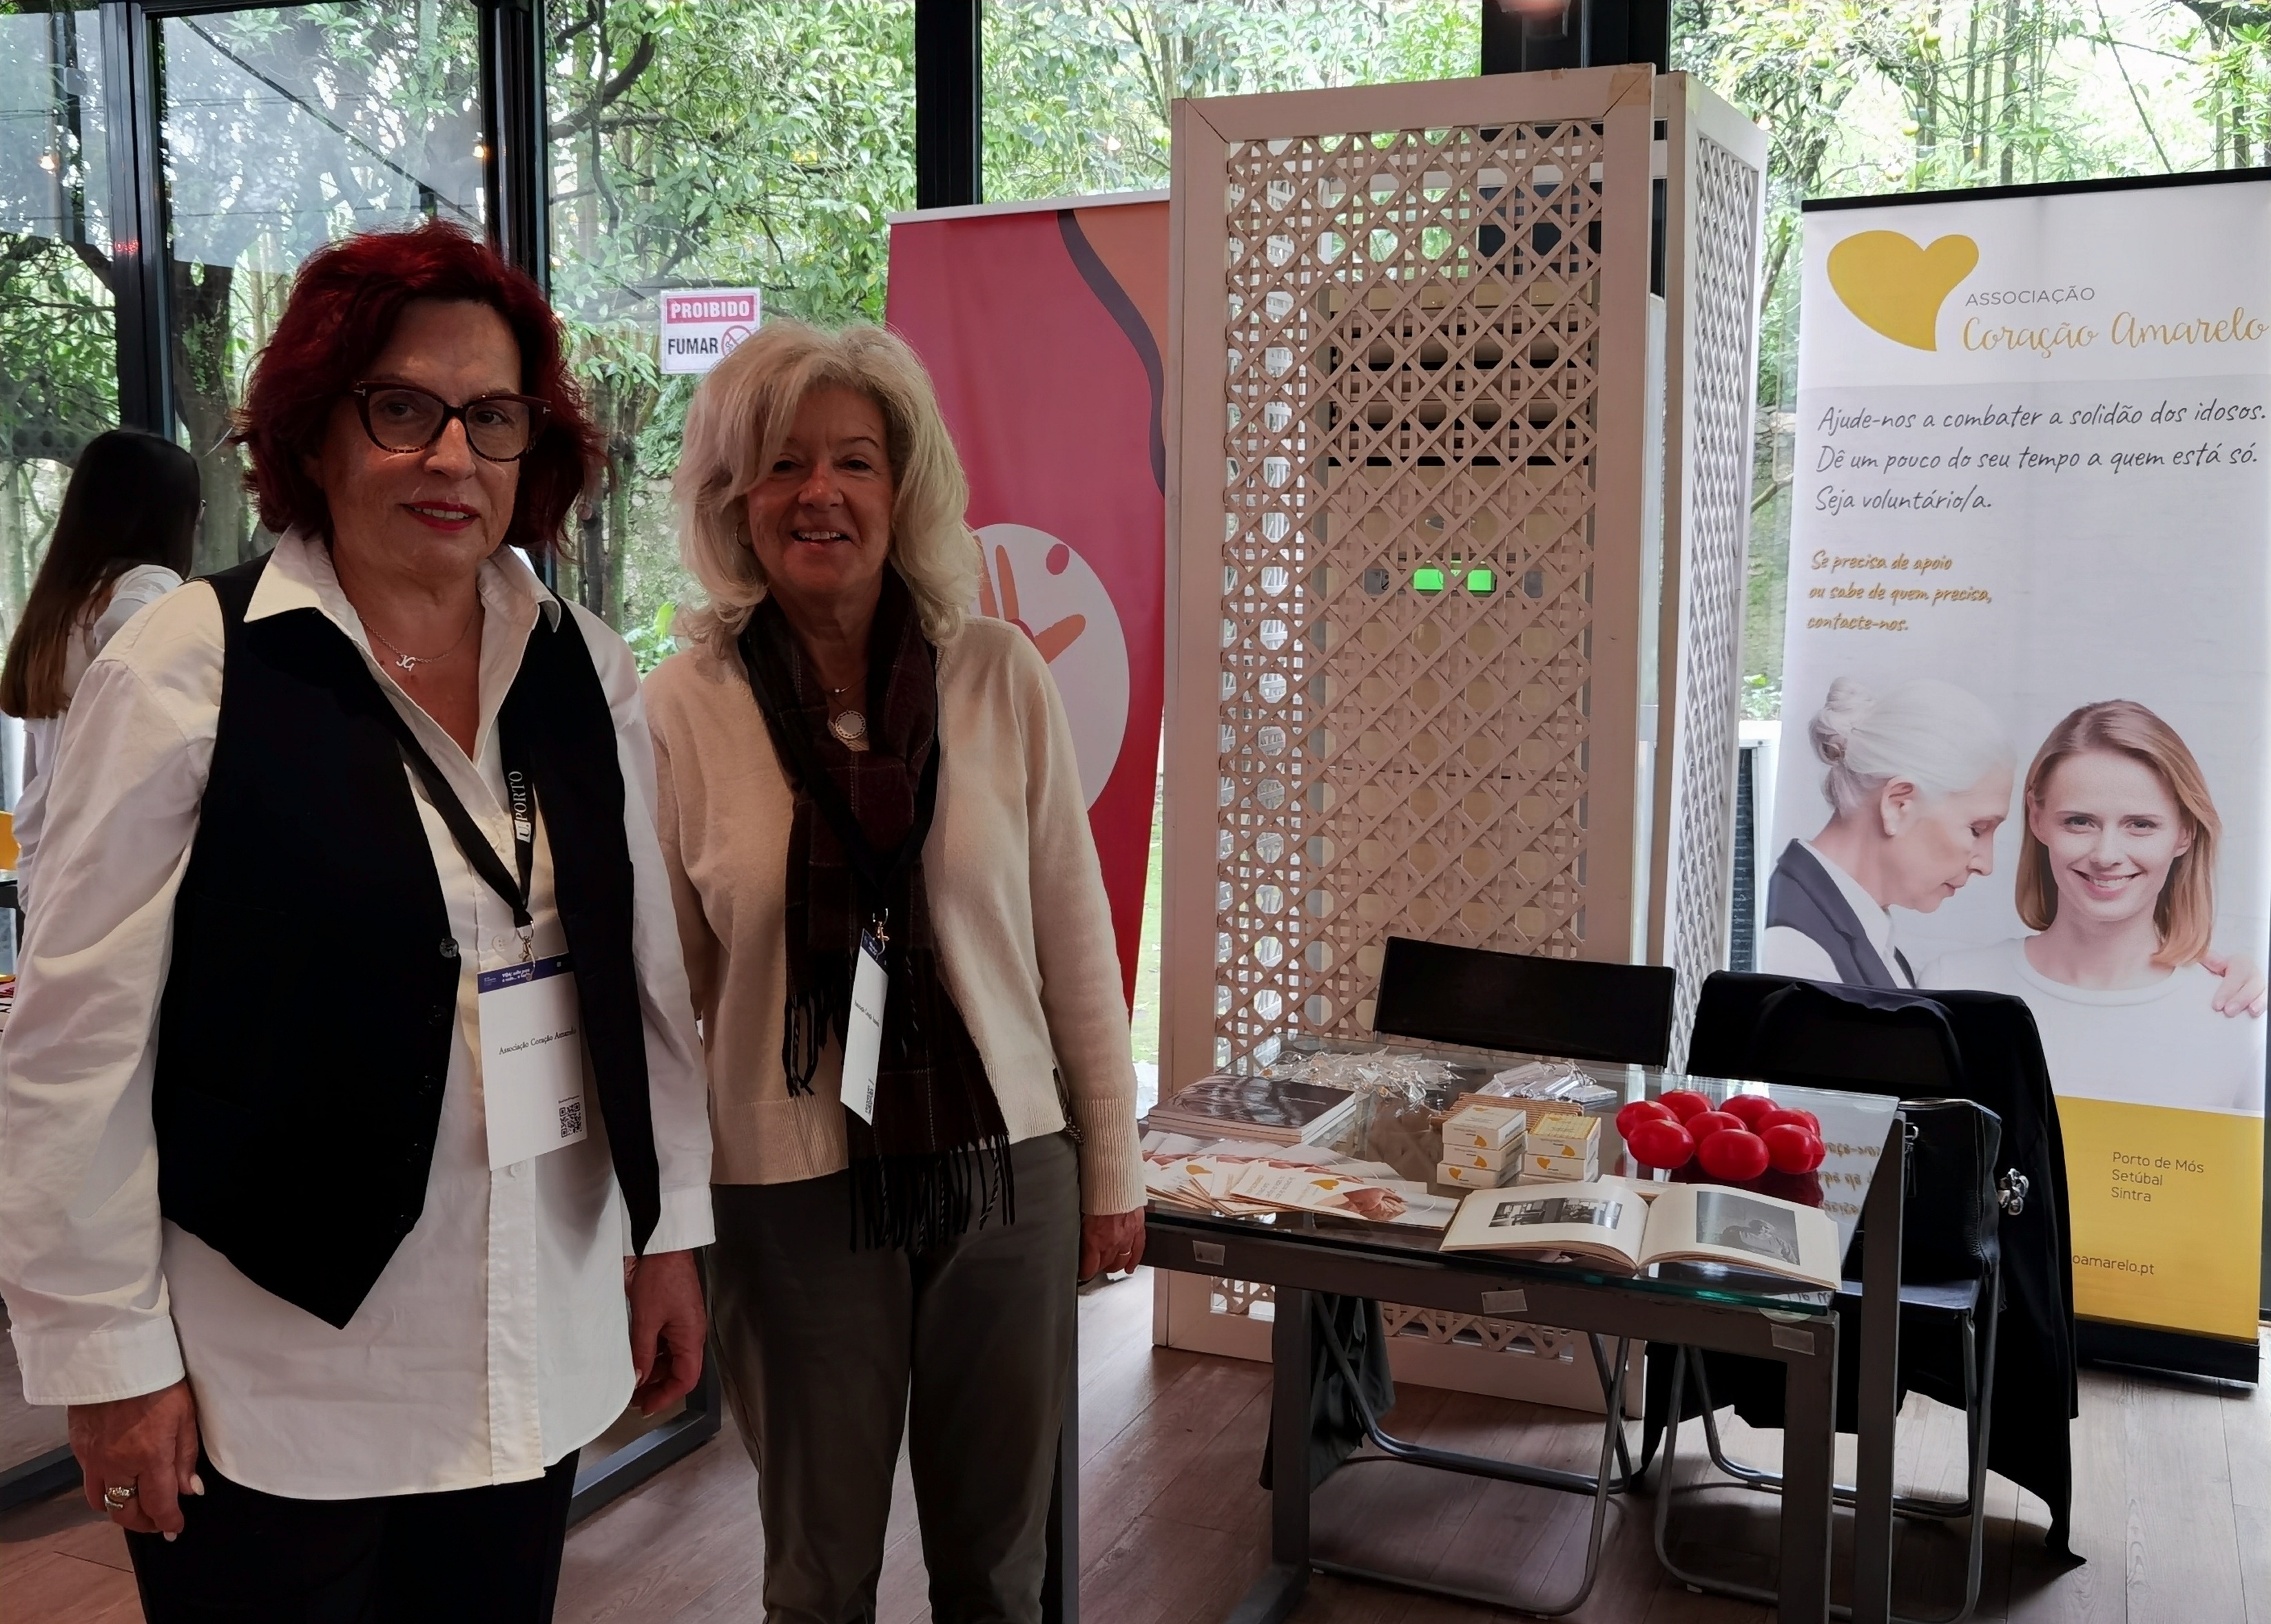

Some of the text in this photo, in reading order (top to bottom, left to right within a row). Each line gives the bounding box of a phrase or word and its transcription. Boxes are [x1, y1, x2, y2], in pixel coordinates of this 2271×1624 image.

[1965, 285, 2095, 306] ASSOCIAÇÃO
[670, 301, 750, 319] PROIBIDO
[1963, 307, 2269, 359] Coração Amarelo
[668, 337, 718, 355] FUMAR
[1818, 398, 2265, 436] Ajude-nos a combater a solidão dos idosos.
[1816, 443, 2257, 474] Dê um pouco do seu tempo a quem está só.
[1816, 485, 1991, 516] Seja voluntário/a.
[1812, 550, 1952, 575] Se precisa de apoio
[1809, 582, 1991, 605] ou sabe de quem precisa,
[1807, 613, 1908, 631] contacte-nos.
[2113, 1152, 2203, 1173] Porto de Mós
[2113, 1169, 2162, 1185] Setúbal
[2111, 1187, 2150, 1202] Sintra
[2073, 1254, 2155, 1276] oamarelo.pt
